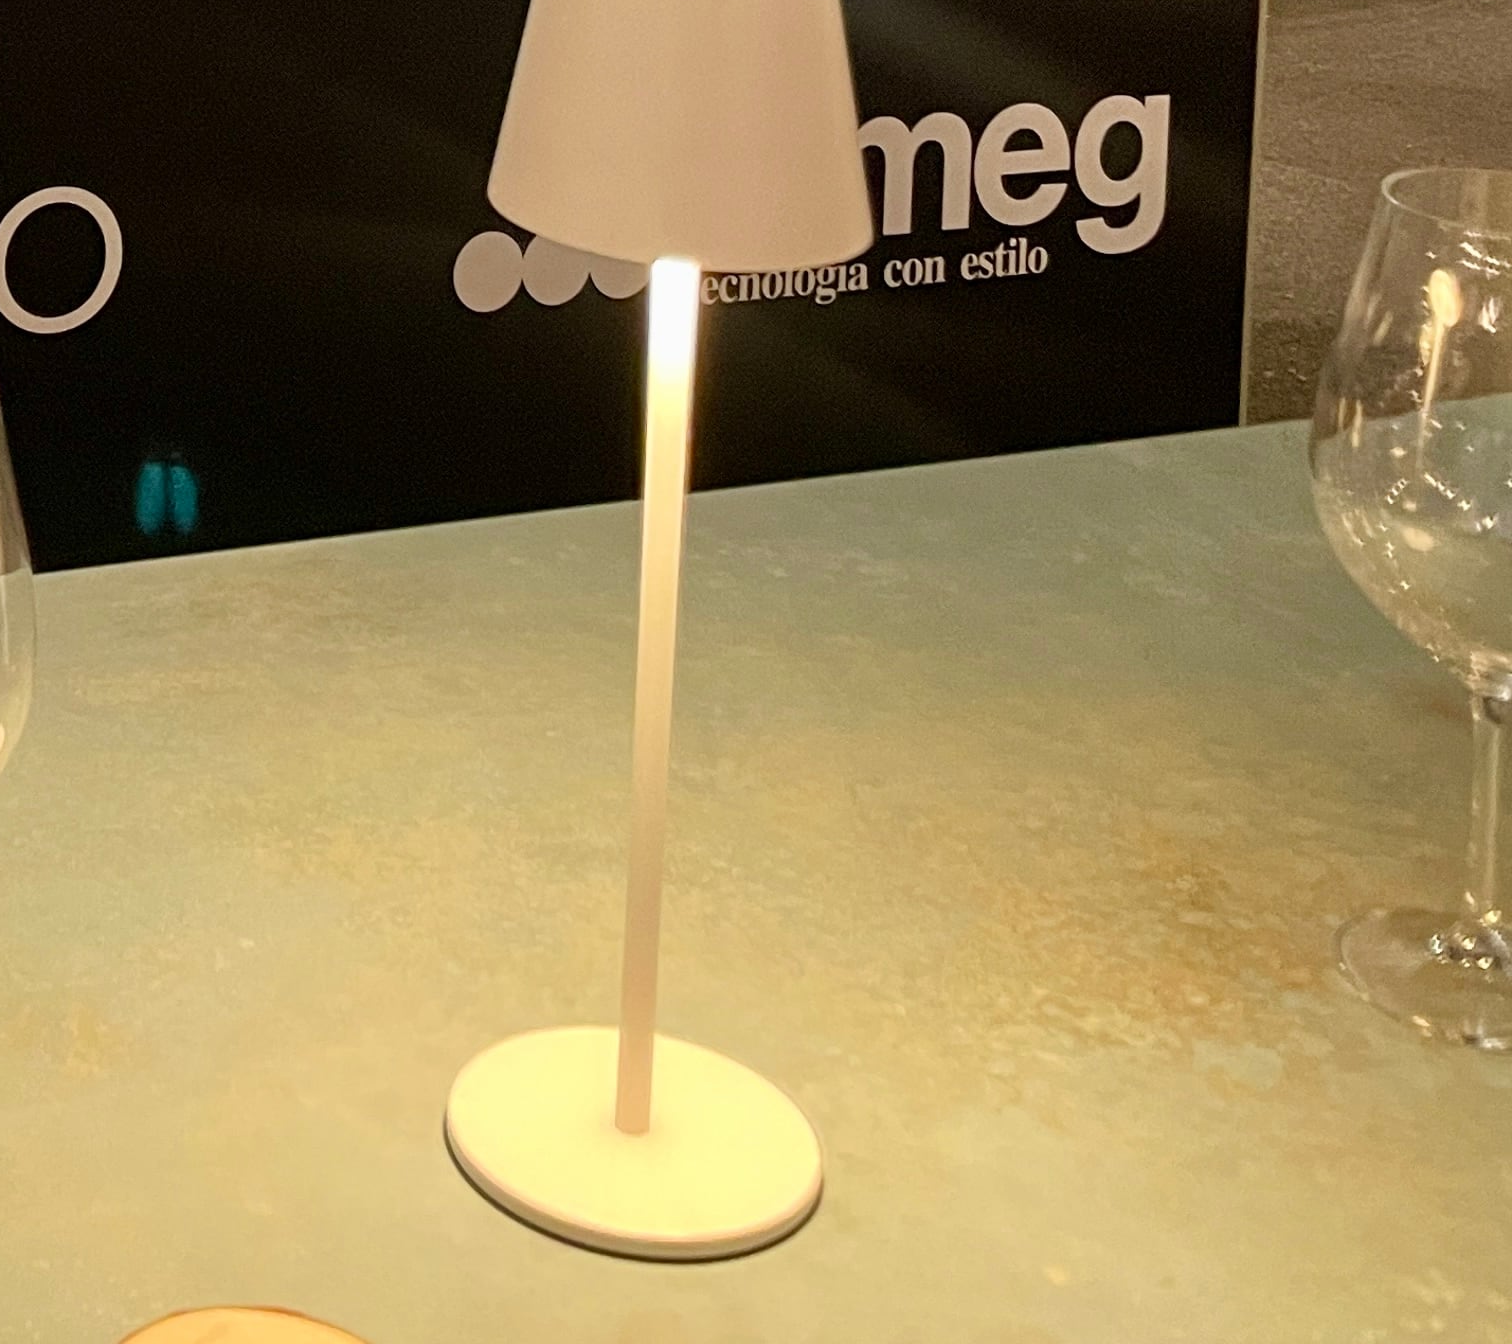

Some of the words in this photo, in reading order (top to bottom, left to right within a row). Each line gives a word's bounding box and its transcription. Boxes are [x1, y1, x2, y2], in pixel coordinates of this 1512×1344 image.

[859, 94, 1171, 254] meg
[883, 255, 946, 288] con
[960, 237, 1048, 280] estilo
